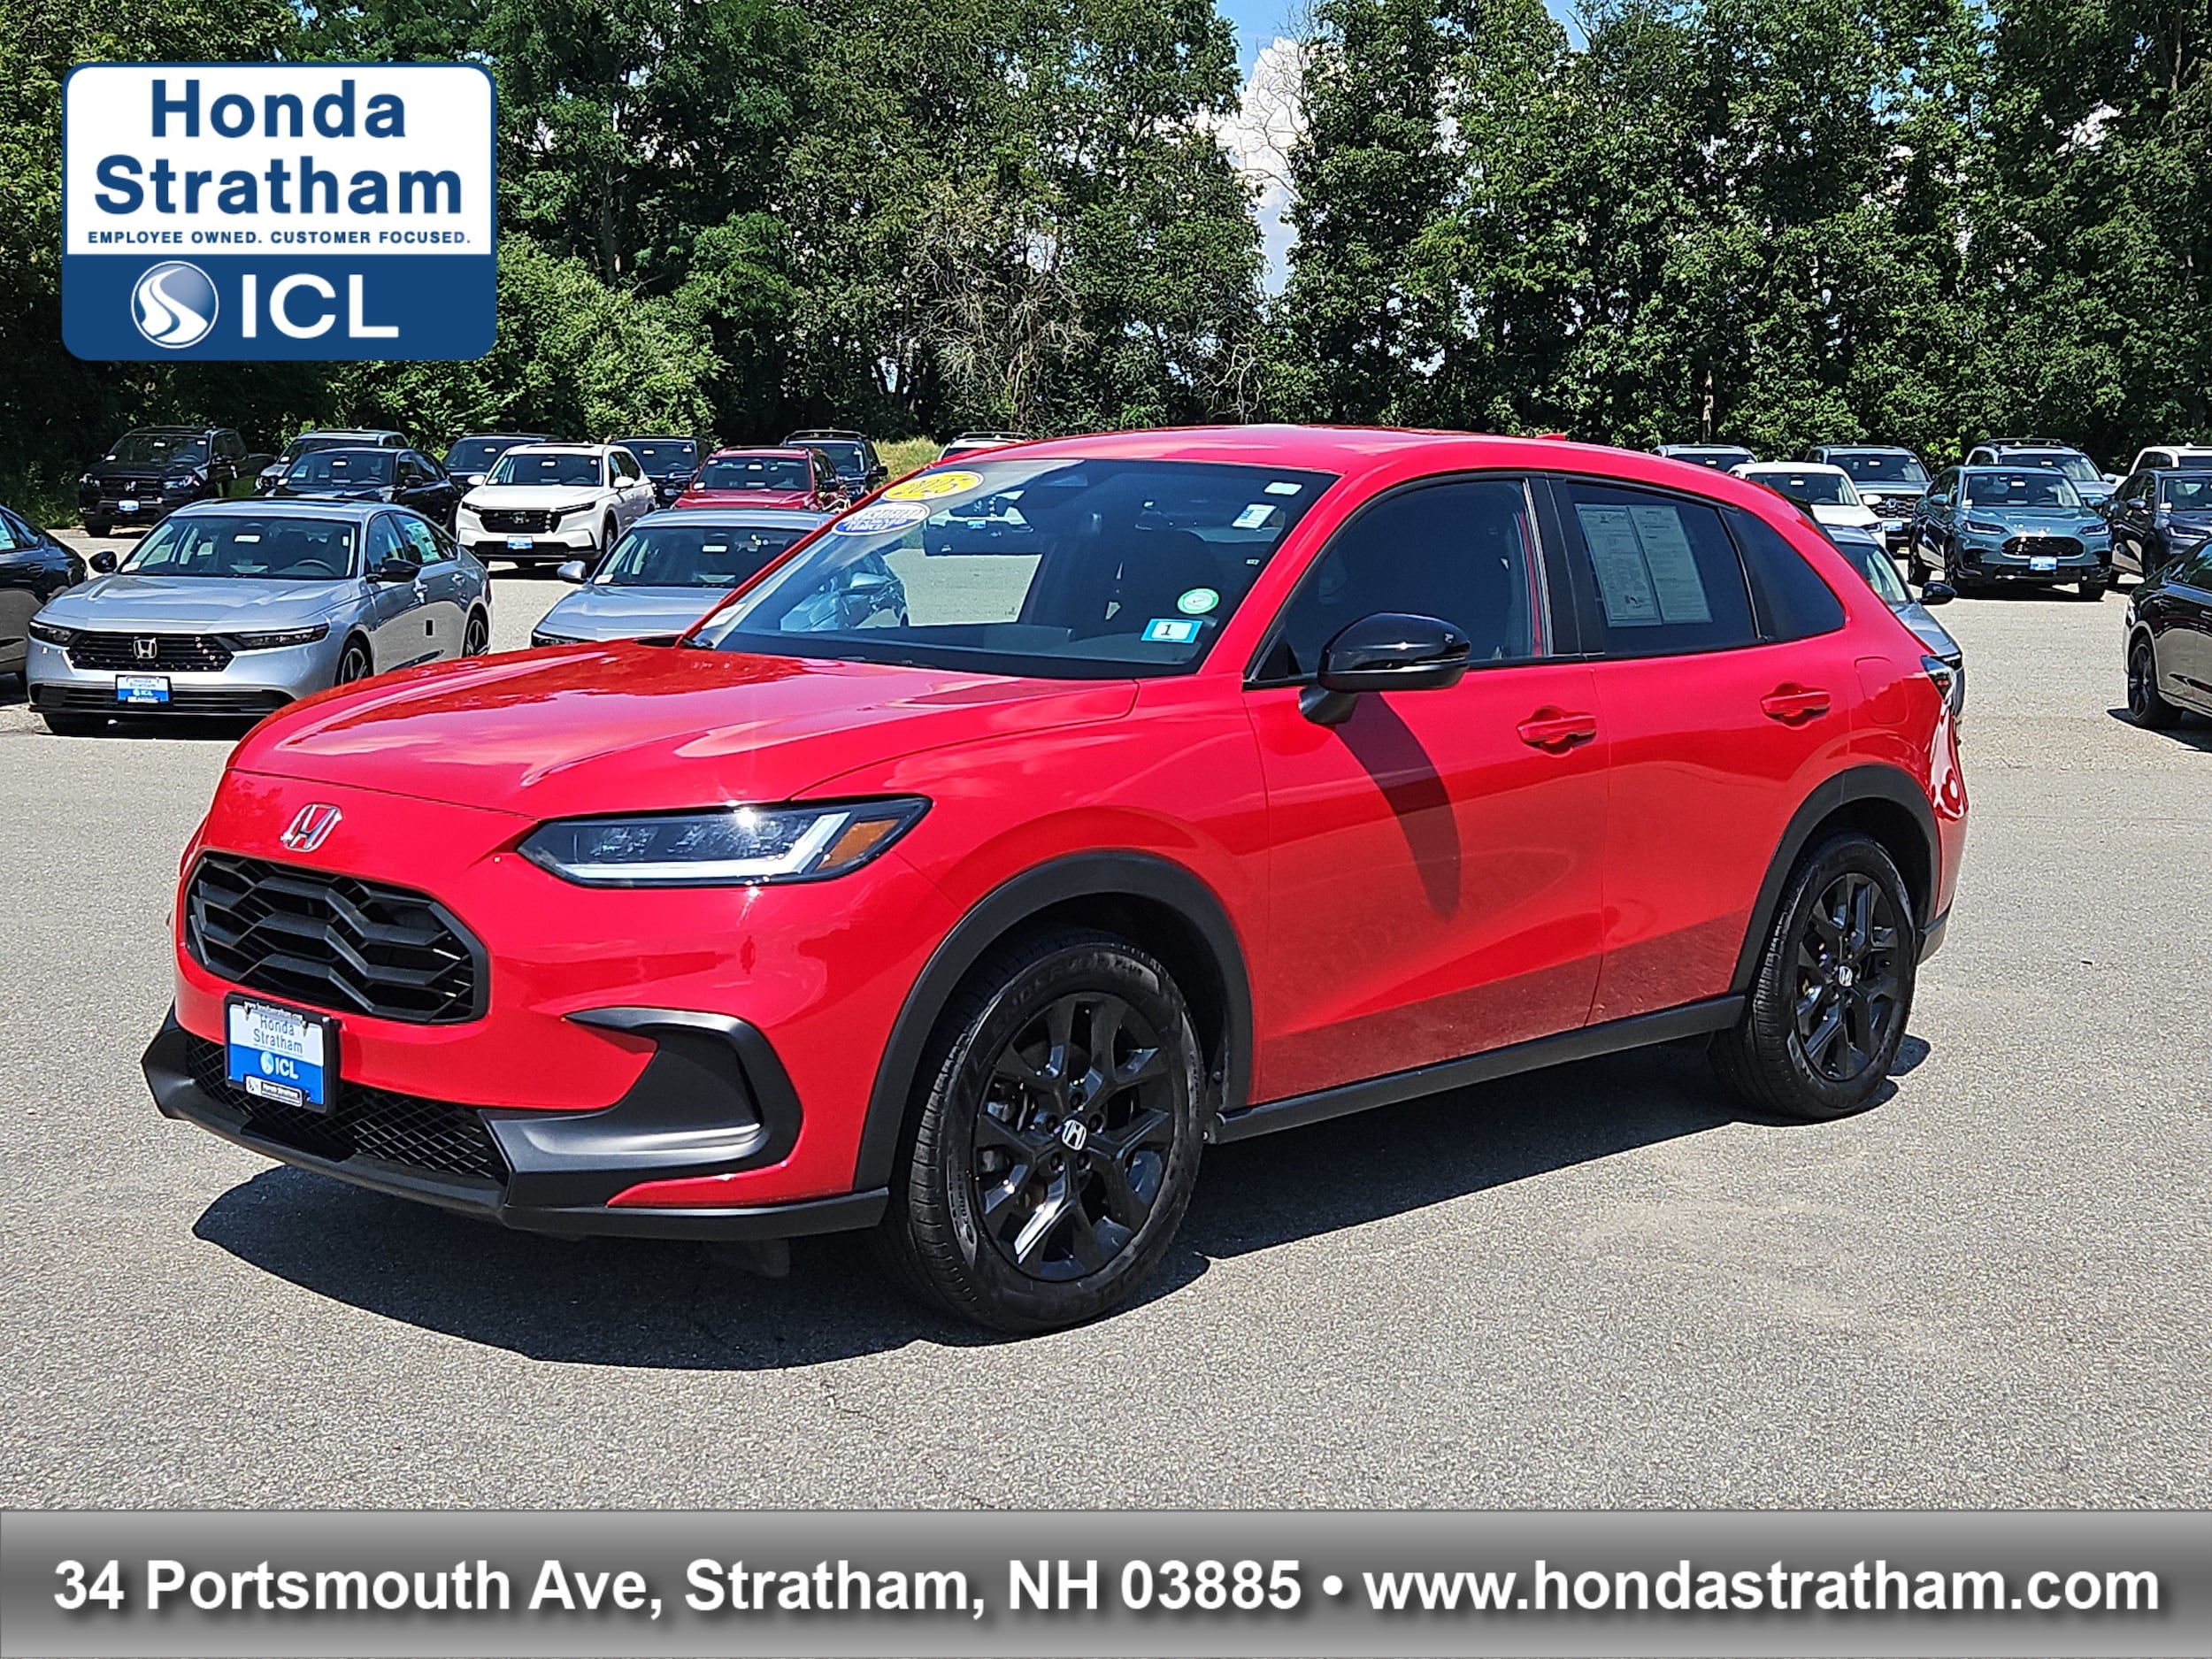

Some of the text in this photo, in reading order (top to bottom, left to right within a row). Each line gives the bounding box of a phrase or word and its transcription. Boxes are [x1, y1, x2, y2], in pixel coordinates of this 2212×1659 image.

[1161, 623, 1171, 635] 1
[260, 1014, 295, 1036] Honda
[253, 1028, 303, 1054] Stratham
[275, 1057, 299, 1079] ICL
